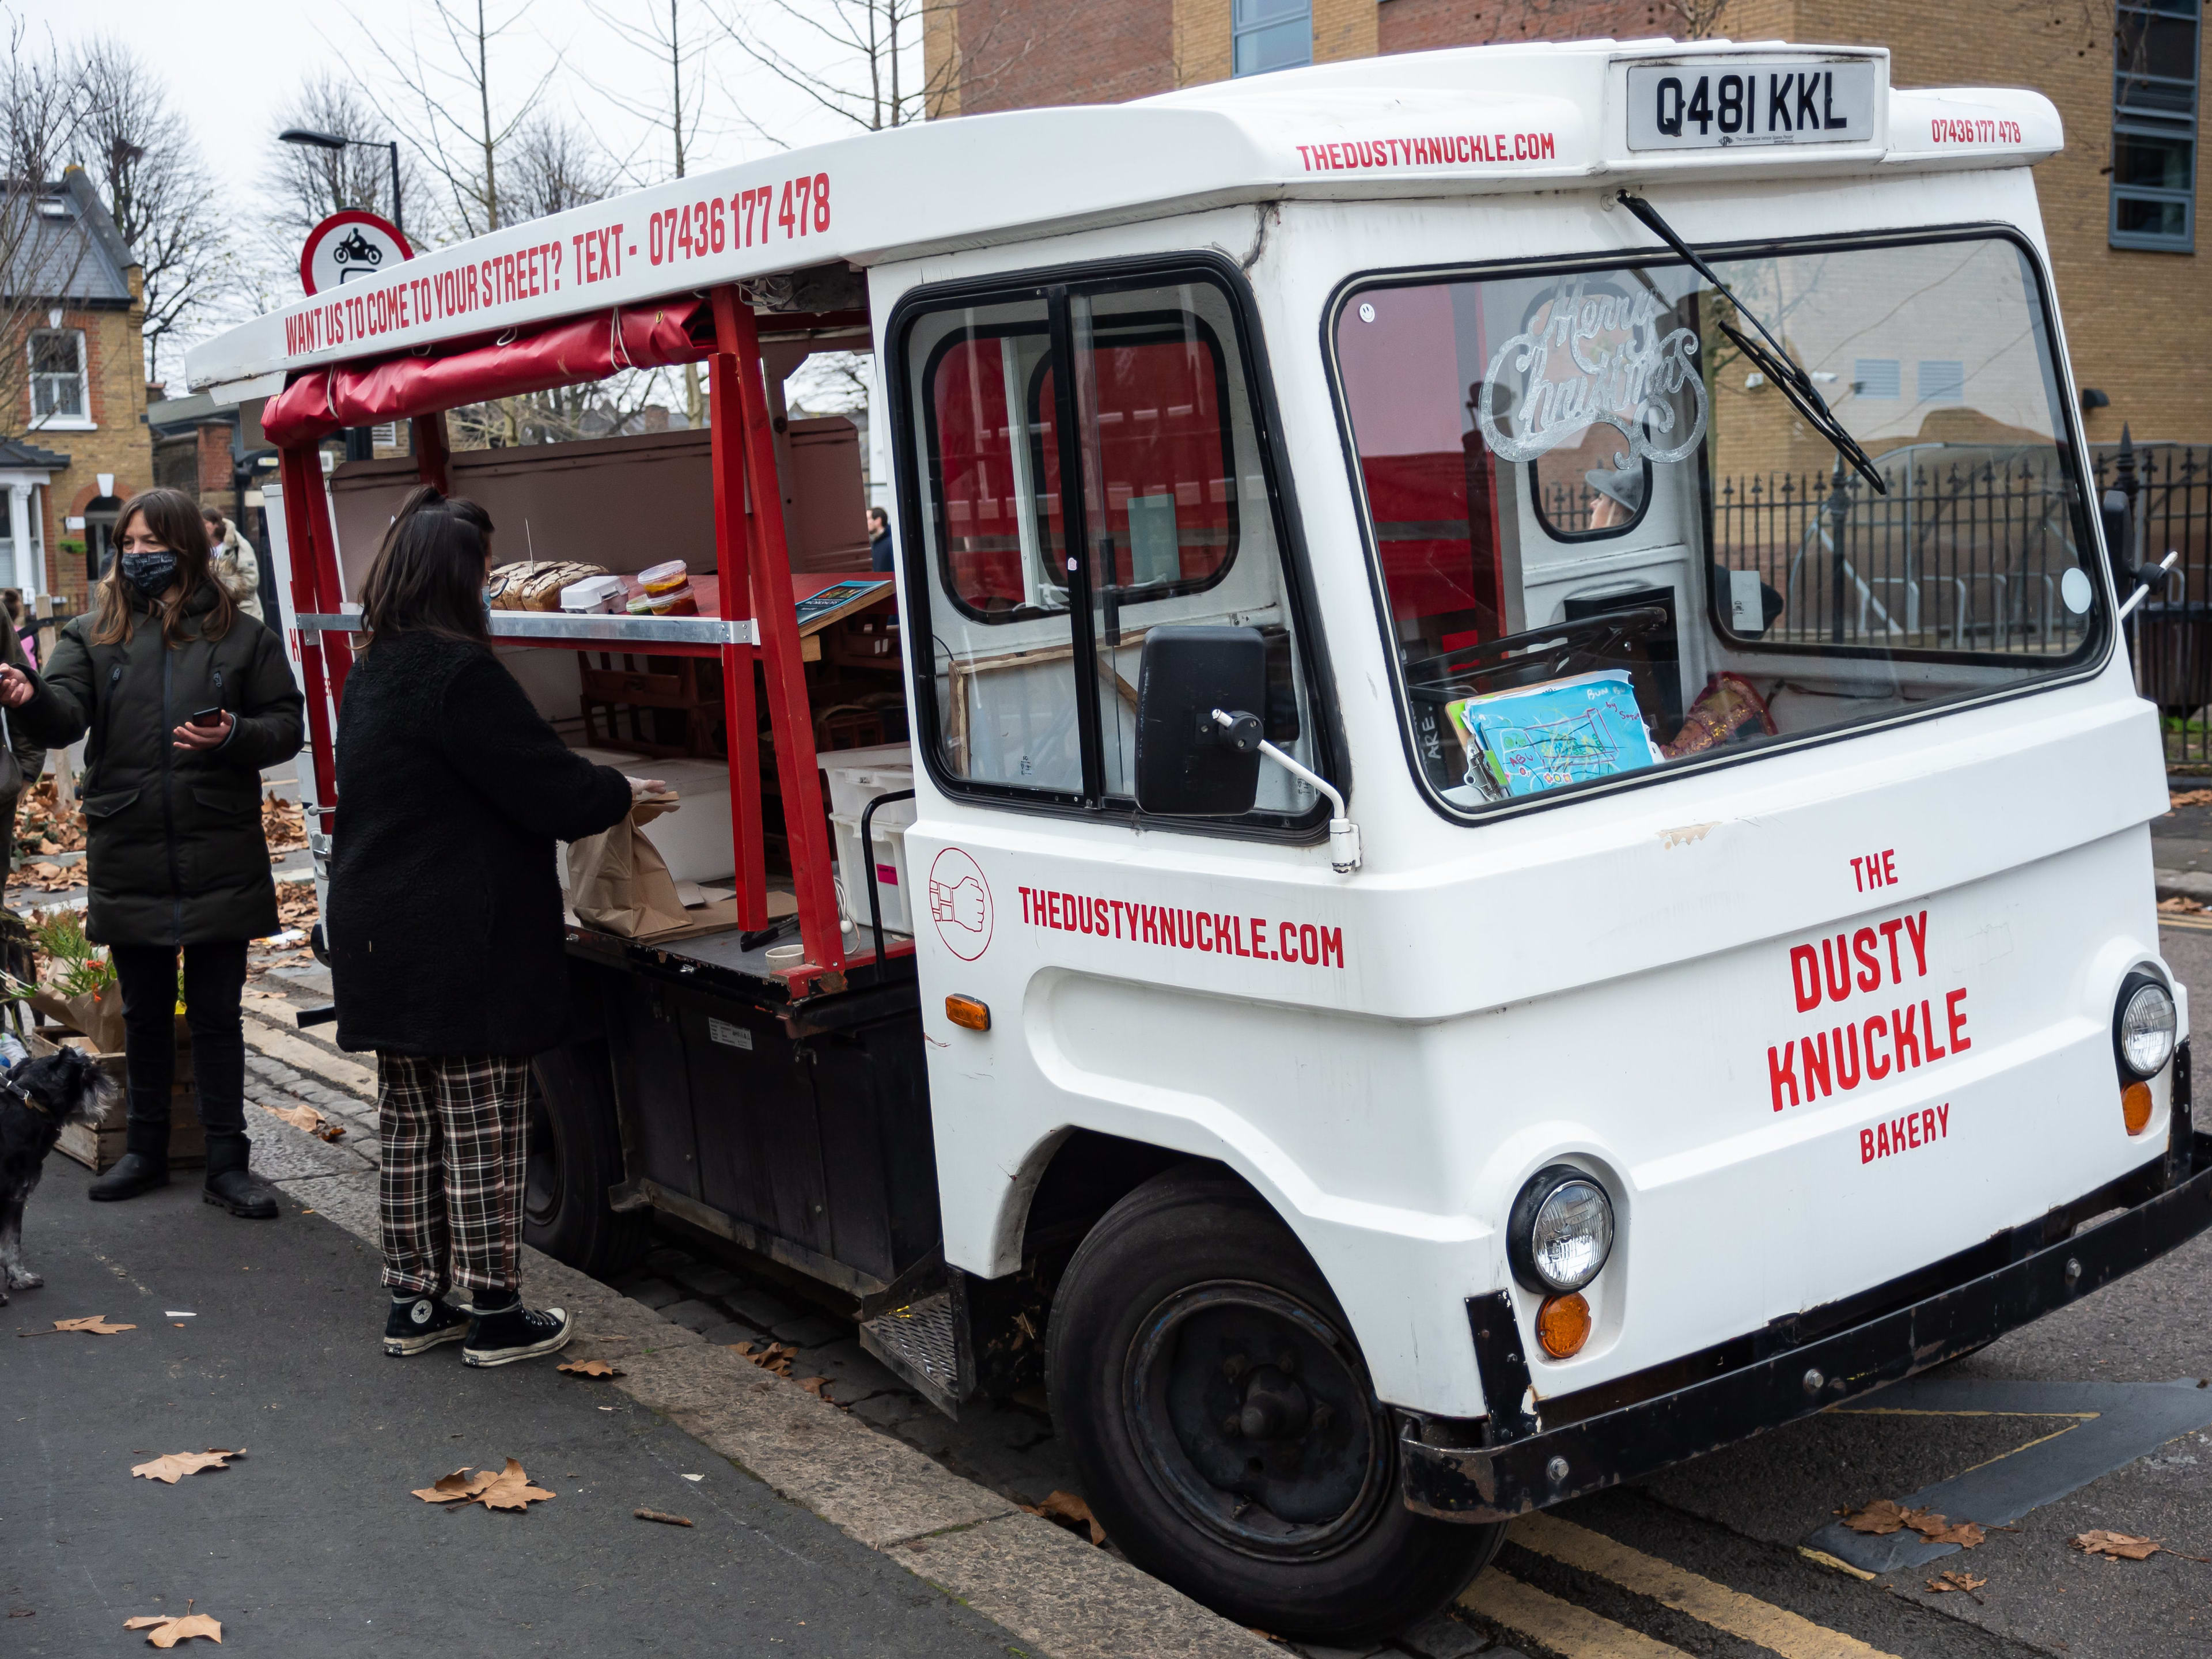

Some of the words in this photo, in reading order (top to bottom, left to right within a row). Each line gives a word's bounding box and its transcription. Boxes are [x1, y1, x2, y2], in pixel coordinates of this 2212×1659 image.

[1657, 75, 1755, 137] Q481
[1768, 72, 1847, 131] KKL
[1931, 119, 1974, 143] 07436
[1975, 120, 1995, 142] 177
[1999, 120, 2021, 143] 478
[1296, 133, 1555, 171] THEDUSTYKNUCKLE.COM
[285, 308, 322, 356] WANT
[325, 302, 344, 346] US
[345, 296, 365, 340] TO
[366, 283, 410, 335] COME
[410, 278, 432, 324] TO
[434, 264, 479, 319] YOUR
[482, 241, 562, 308] STREET?
[573, 224, 623, 285] TEXT
[649, 198, 725, 266] 07436
[730, 185, 772, 249] 177
[778, 172, 830, 238] 478
[1528, 274, 1659, 363] Merry
[1479, 328, 1708, 468] Christmas
[1850, 849, 1899, 893] THE
[1018, 886, 1344, 969] THEDUSTYKNUCKLE.COM
[1789, 910, 1927, 1013] DUSTY
[1767, 987, 1972, 1112] KNUCKLE
[1859, 1103, 1949, 1165] BAKERY
